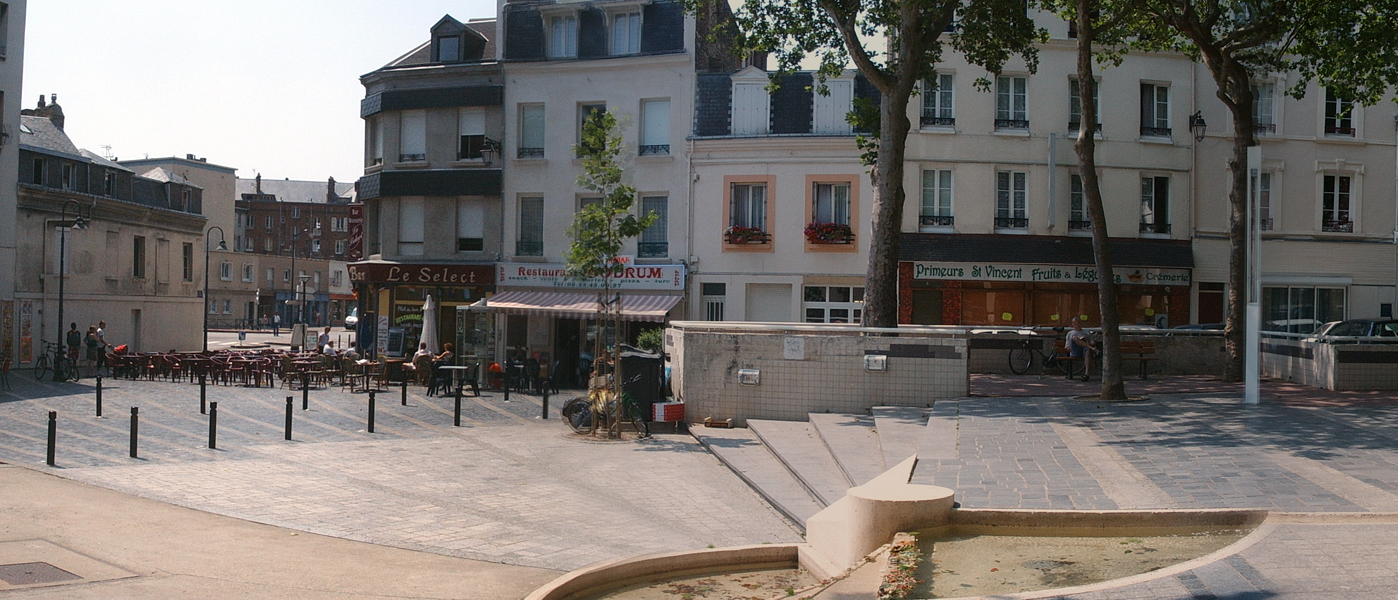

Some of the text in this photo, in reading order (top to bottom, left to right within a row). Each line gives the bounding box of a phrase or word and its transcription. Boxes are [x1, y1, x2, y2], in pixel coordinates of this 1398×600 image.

[349, 266, 365, 281] Bar
[387, 266, 476, 283] Le Select
[916, 264, 964, 278] Primeurs
[971, 265, 982, 278] St
[985, 265, 1022, 279] Vincent
[1031, 267, 1062, 281] Fruits
[1146, 272, 1189, 283] Crémerie
